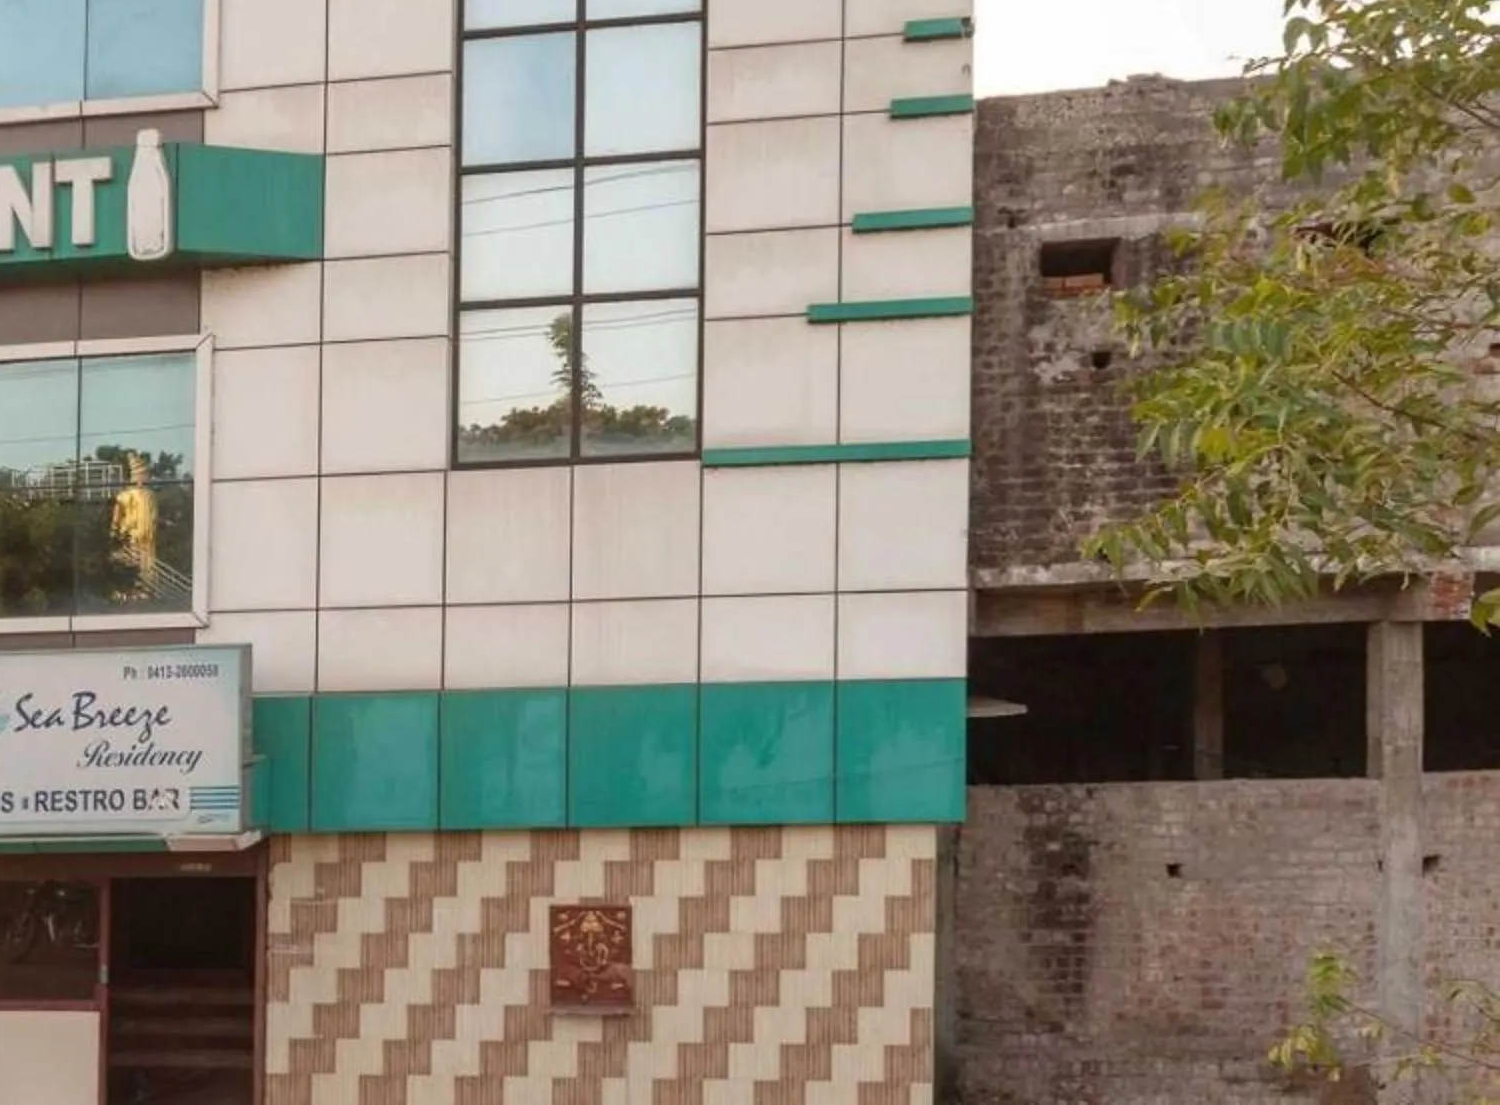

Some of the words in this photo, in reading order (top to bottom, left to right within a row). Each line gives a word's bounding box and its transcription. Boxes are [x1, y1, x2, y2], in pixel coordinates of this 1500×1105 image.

[13, 692, 65, 733] Sea
[71, 690, 172, 744] Breeze
[76, 741, 204, 775] Residency
[34, 788, 126, 813] RESTRO
